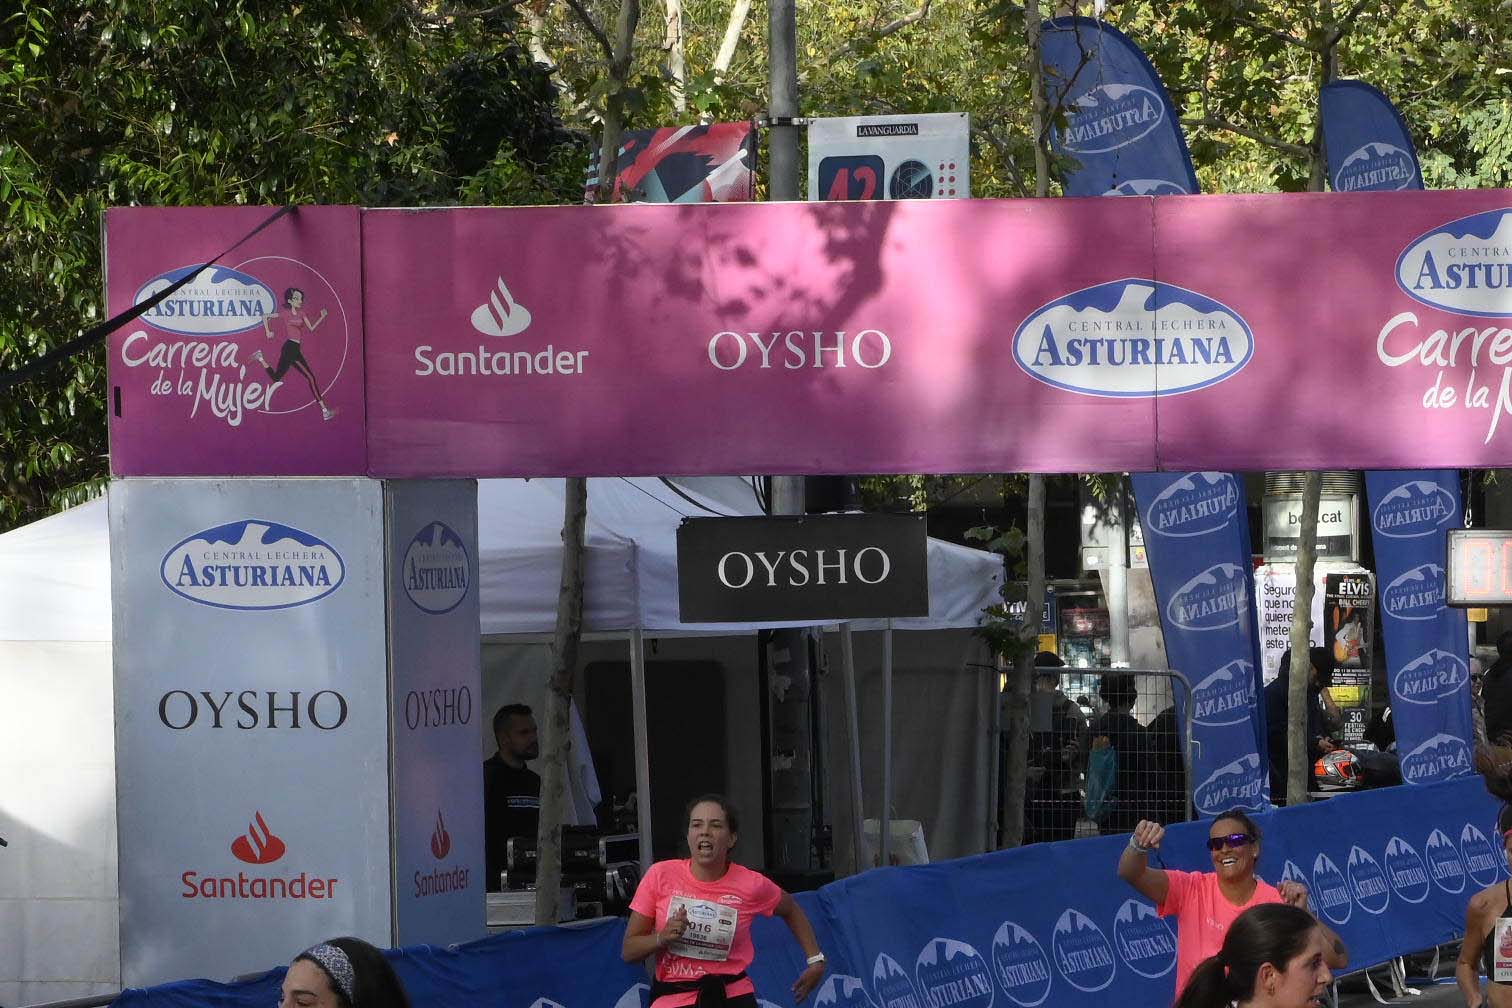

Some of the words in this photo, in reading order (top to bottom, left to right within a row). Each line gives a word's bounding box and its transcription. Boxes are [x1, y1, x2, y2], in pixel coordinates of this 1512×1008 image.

[143, 288, 265, 318] ASTURIANA
[1068, 320, 1143, 332] CENTRAL
[1151, 318, 1227, 331] LECHERA
[121, 331, 240, 368] Carrera
[413, 344, 589, 377] Santander
[707, 328, 893, 371] OYSHO
[1031, 323, 1236, 367] ASTURIANA
[150, 371, 173, 395] de
[177, 368, 193, 396] la
[190, 363, 284, 427] Mujer
[1422, 371, 1457, 410] de
[1464, 369, 1490, 410] la
[175, 553, 332, 587] ASTURIANA
[203, 550, 260, 560] CENTRAL
[266, 549, 327, 560] LECHERA
[718, 547, 891, 589] OYSHO
[407, 556, 466, 592] ASTURIANA
[1338, 582, 1370, 596] ELVIS
[1264, 600, 1280, 612] que
[1266, 639, 1285, 650] este
[158, 690, 349, 730] OYSHO
[405, 686, 472, 731] OYSHO
[181, 871, 338, 899] Santander
[414, 865, 470, 899] Santander
